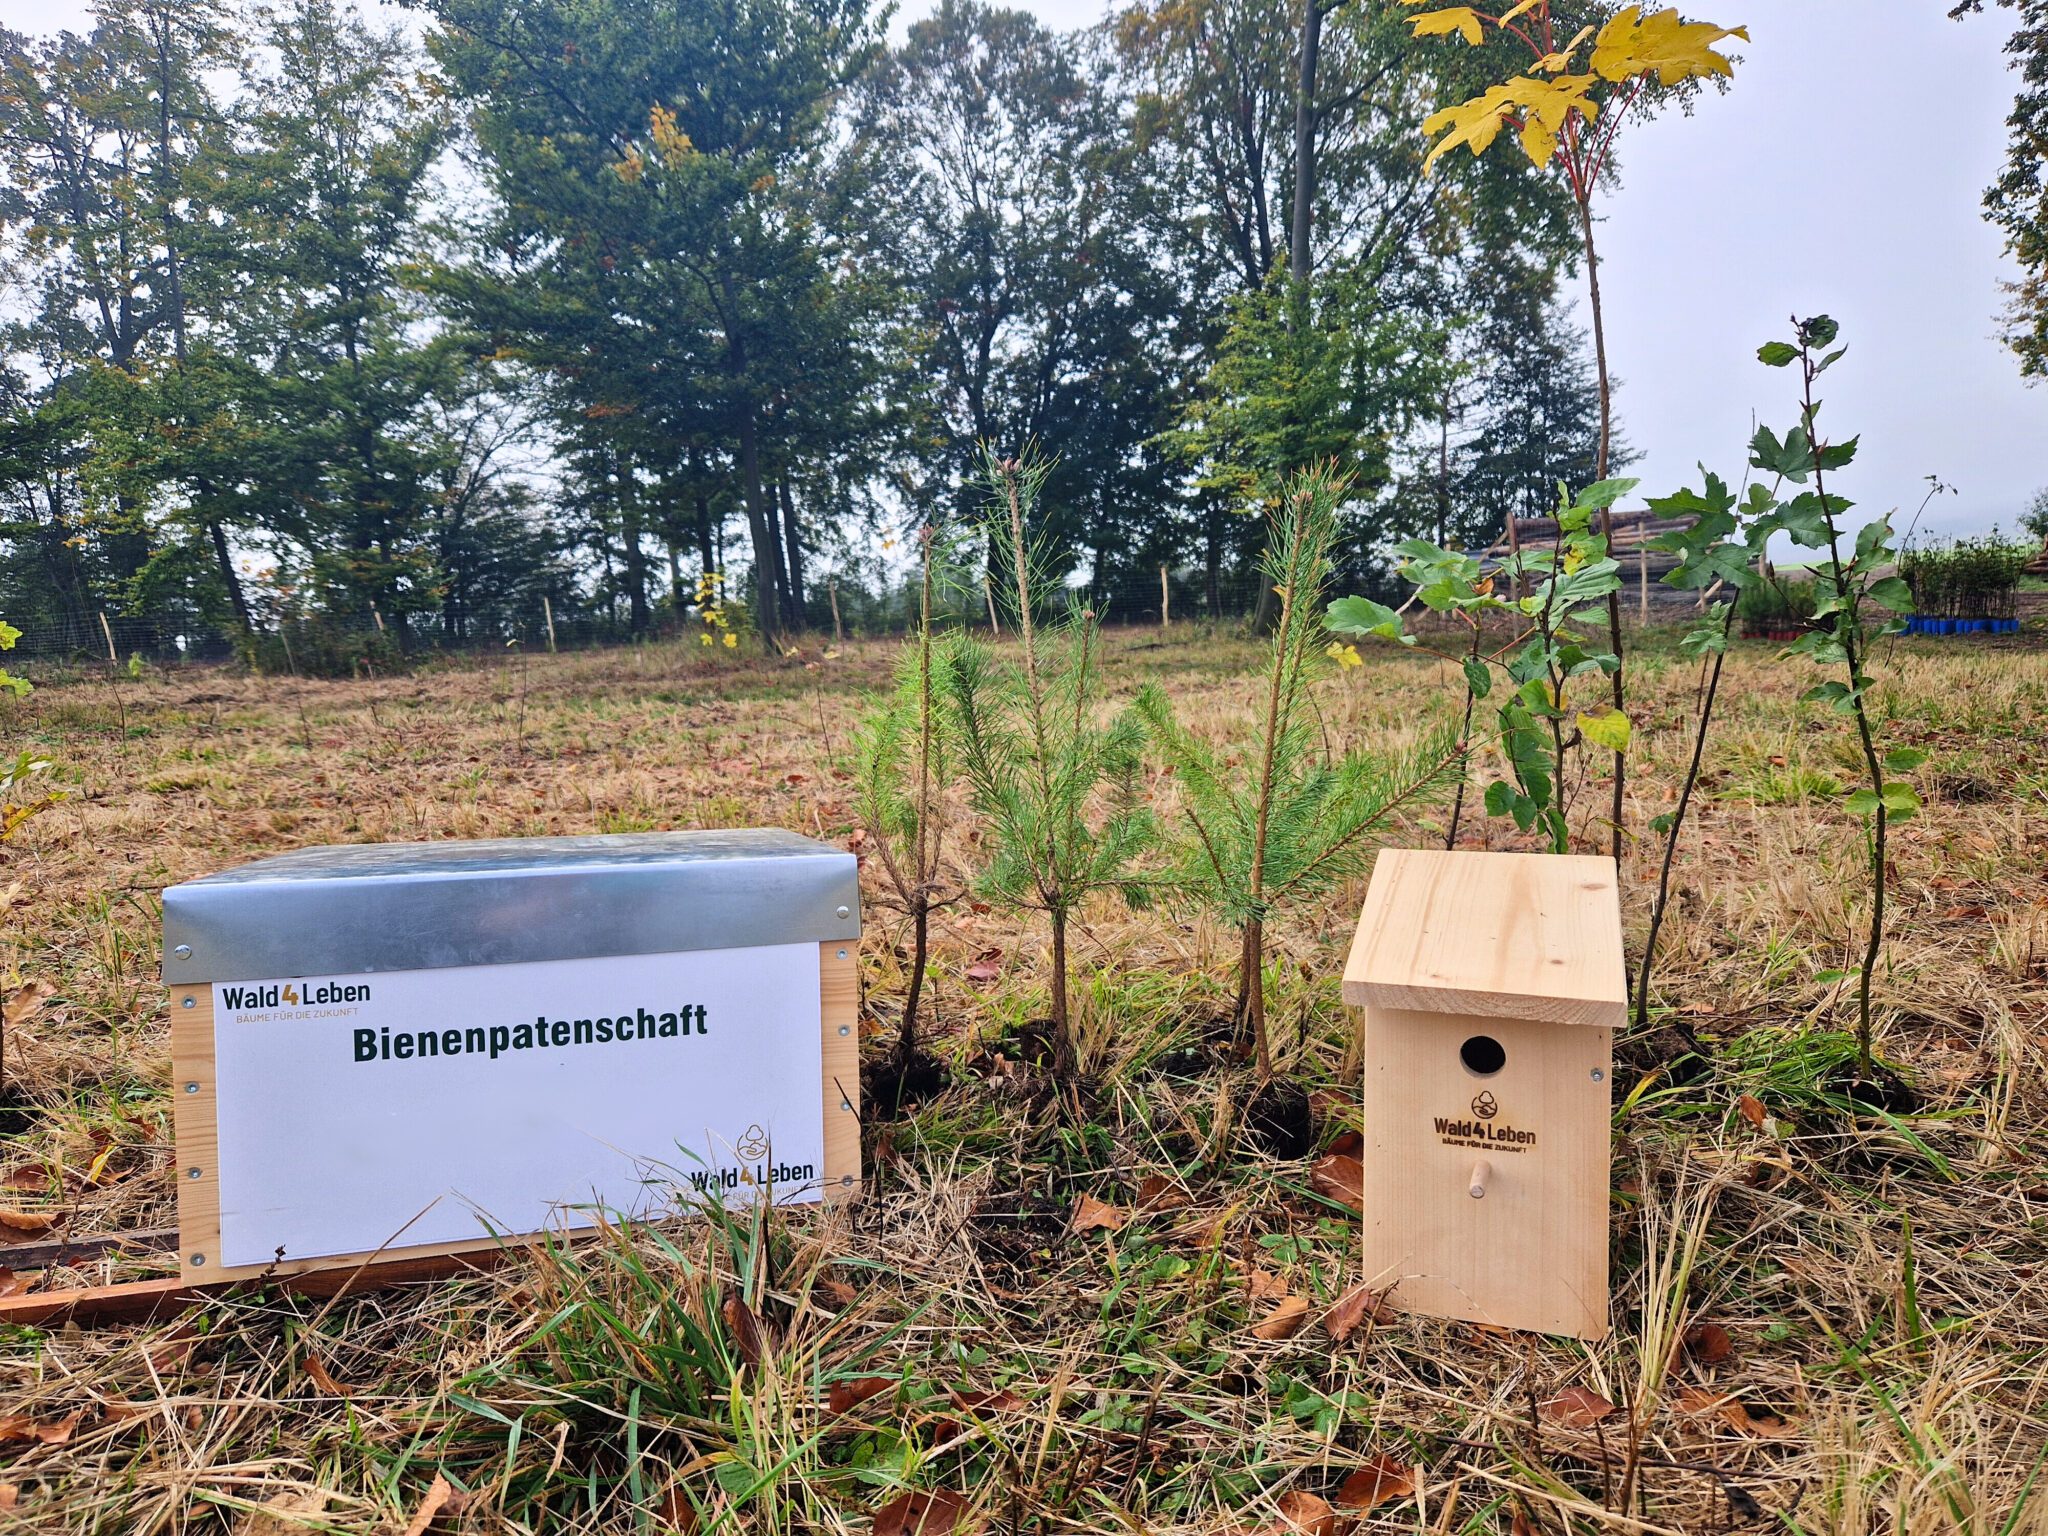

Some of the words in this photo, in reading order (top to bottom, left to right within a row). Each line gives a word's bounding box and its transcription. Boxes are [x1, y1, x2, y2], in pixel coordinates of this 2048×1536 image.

[236, 1013, 270, 1024] BÄUME
[273, 1010, 293, 1021] FÜR
[295, 1010, 311, 1019] DIE
[314, 1007, 358, 1018] ZUKUNFT
[353, 1004, 708, 1062] Bienenpatenschaft
[1442, 1137, 1466, 1147] BÄUME
[1466, 1140, 1481, 1149] FÜR
[1482, 1142, 1493, 1151] DIE
[1494, 1143, 1527, 1154] ZUKUNFT
